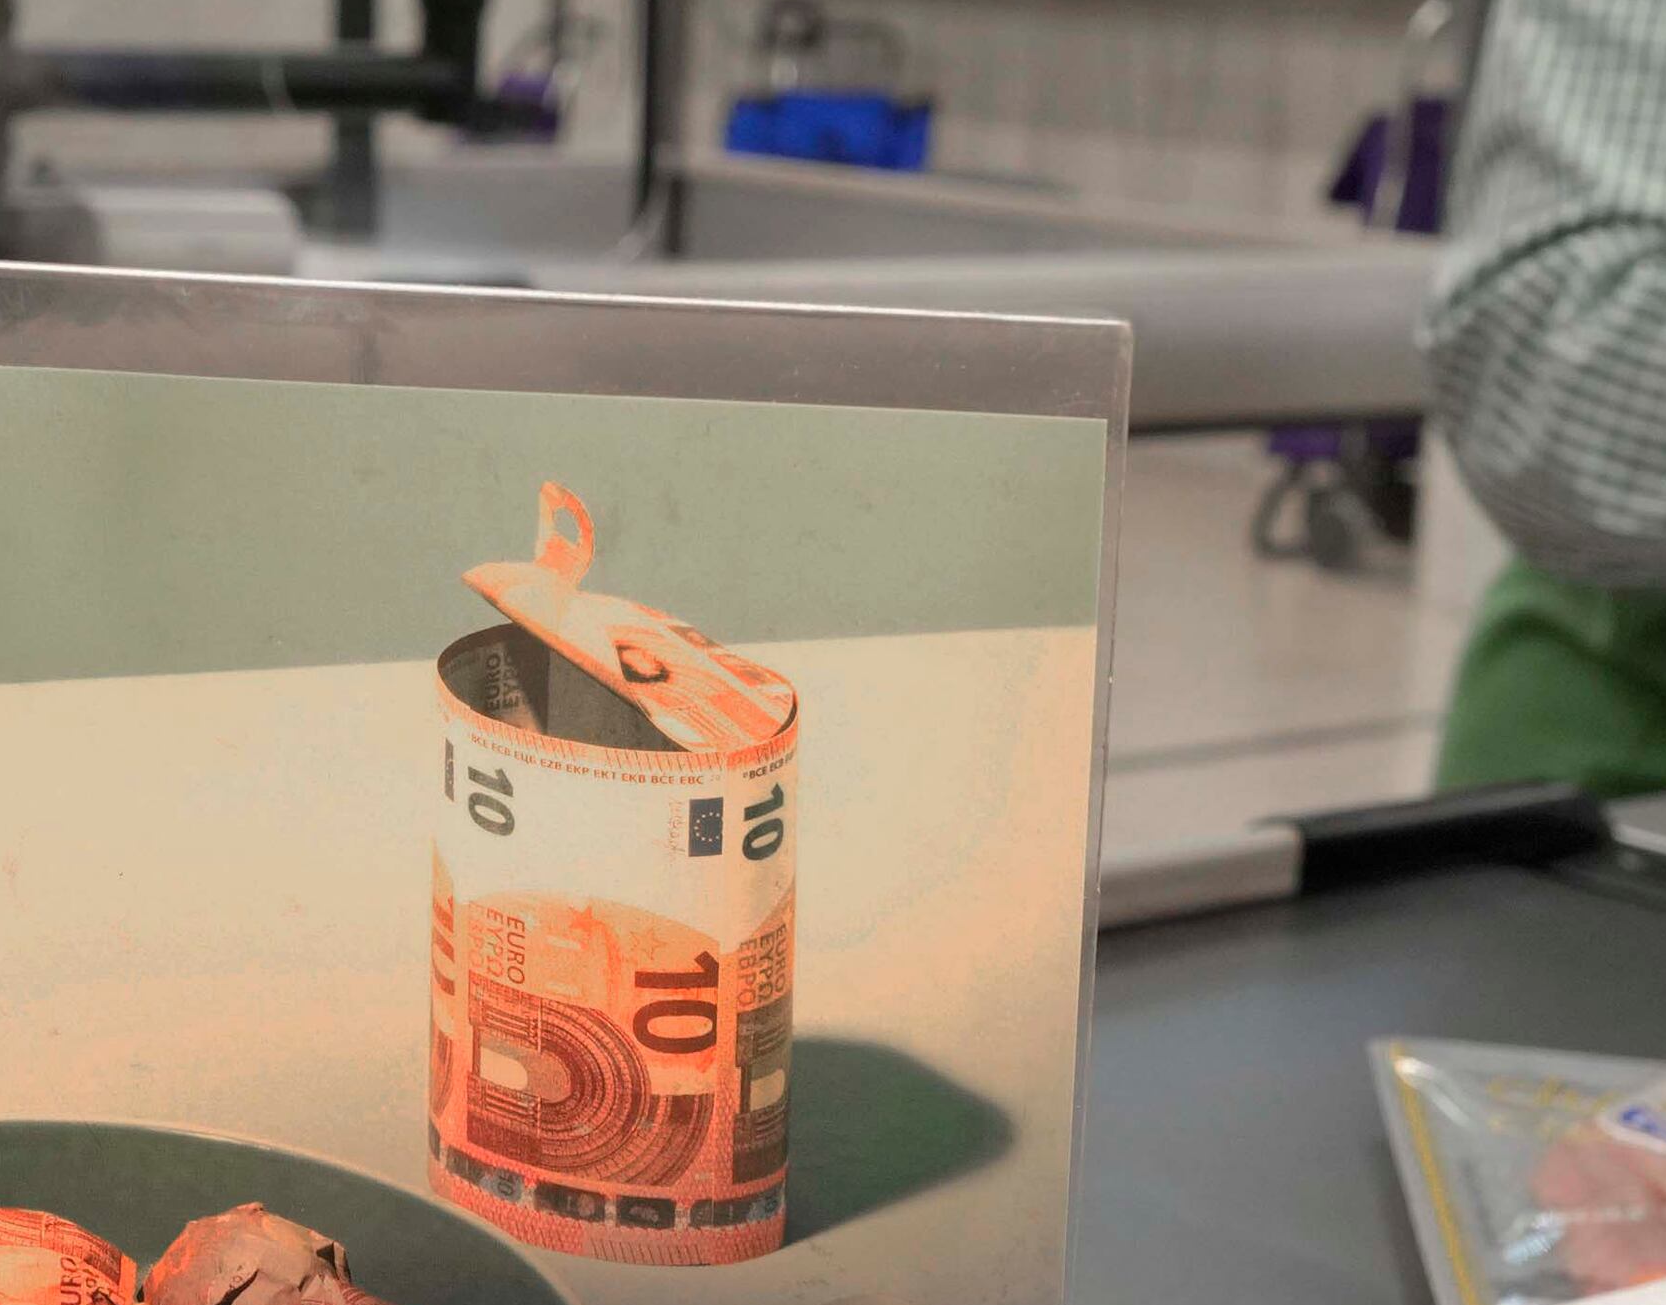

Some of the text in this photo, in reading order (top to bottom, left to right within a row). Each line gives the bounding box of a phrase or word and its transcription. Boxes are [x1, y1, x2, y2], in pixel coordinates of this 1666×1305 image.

[467, 765, 515, 837] 10
[741, 781, 784, 862] 10
[506, 915, 526, 986] EURO
[633, 950, 720, 1055] 10
